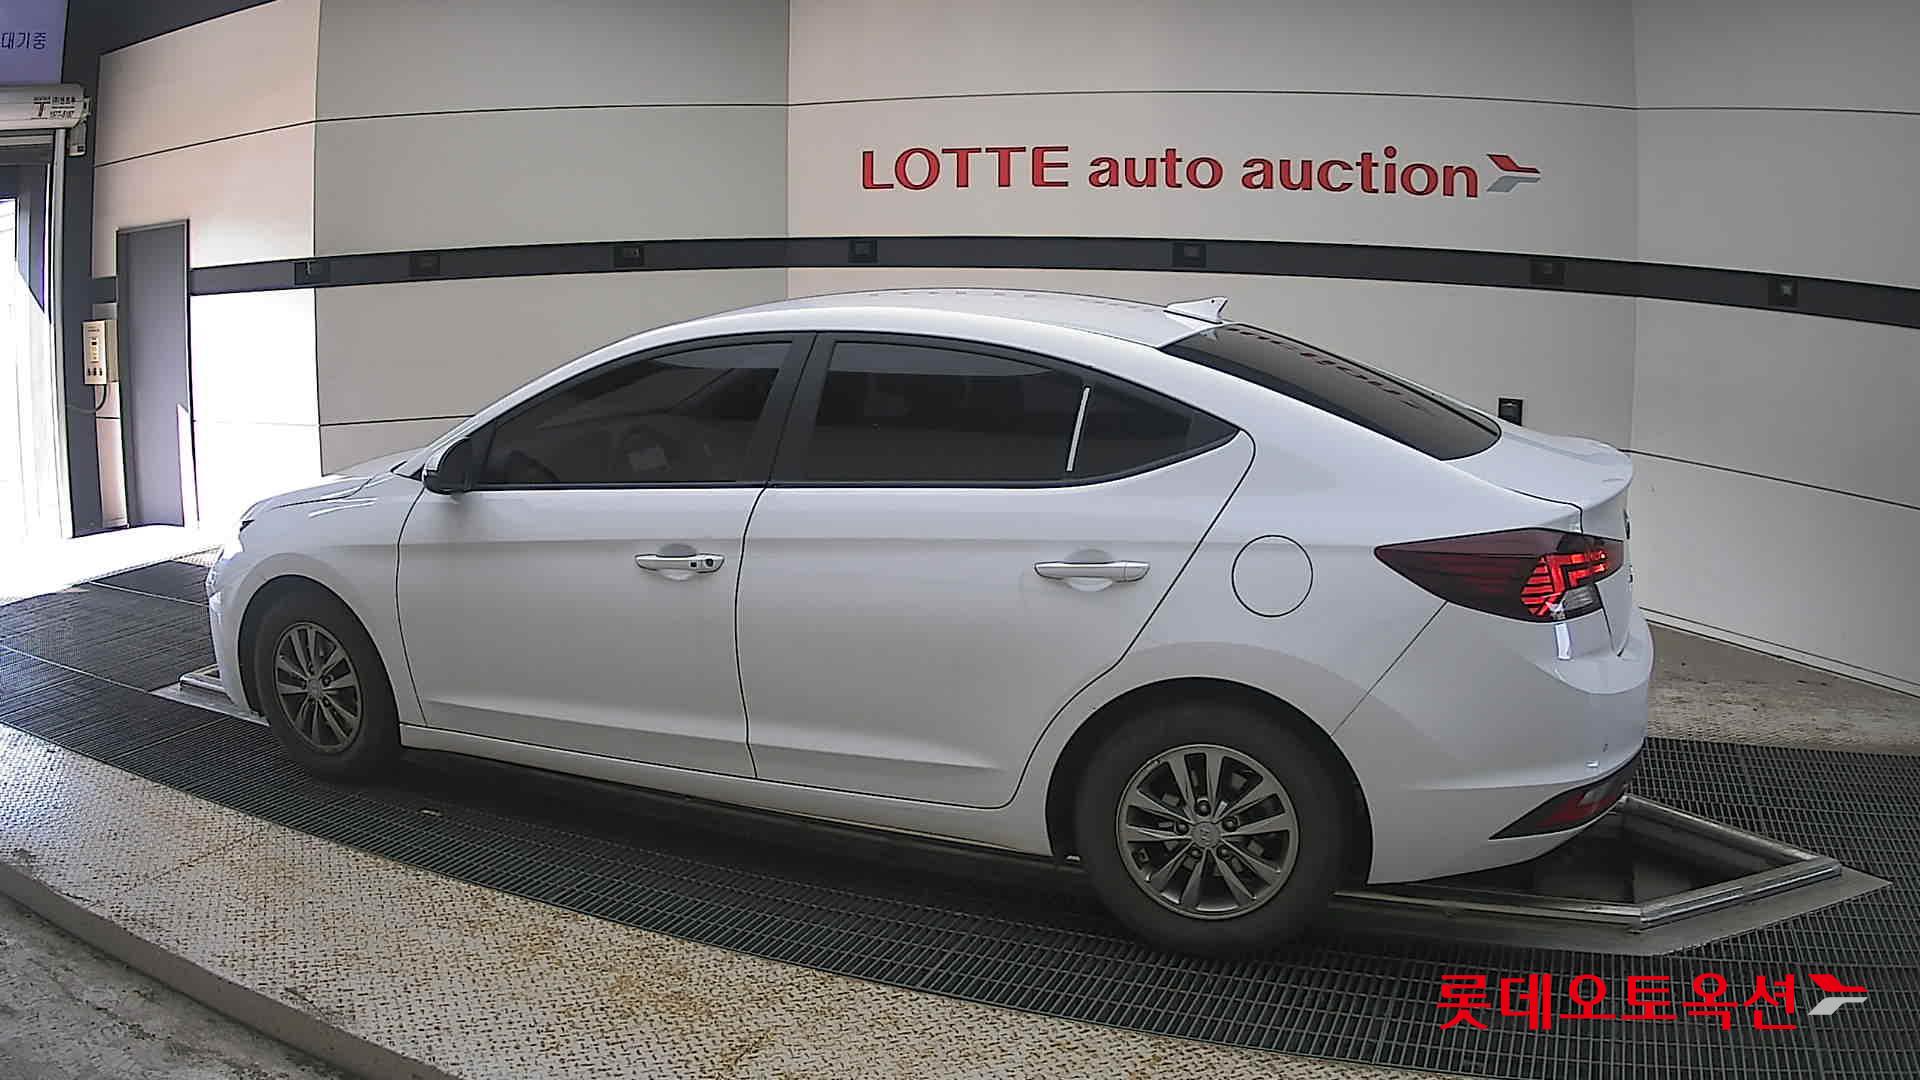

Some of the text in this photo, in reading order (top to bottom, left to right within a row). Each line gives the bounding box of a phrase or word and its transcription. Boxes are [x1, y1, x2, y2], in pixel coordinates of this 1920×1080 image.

[1, 32, 47, 49] 대기중
[862, 146, 1478, 197] LOTTE auto auction
